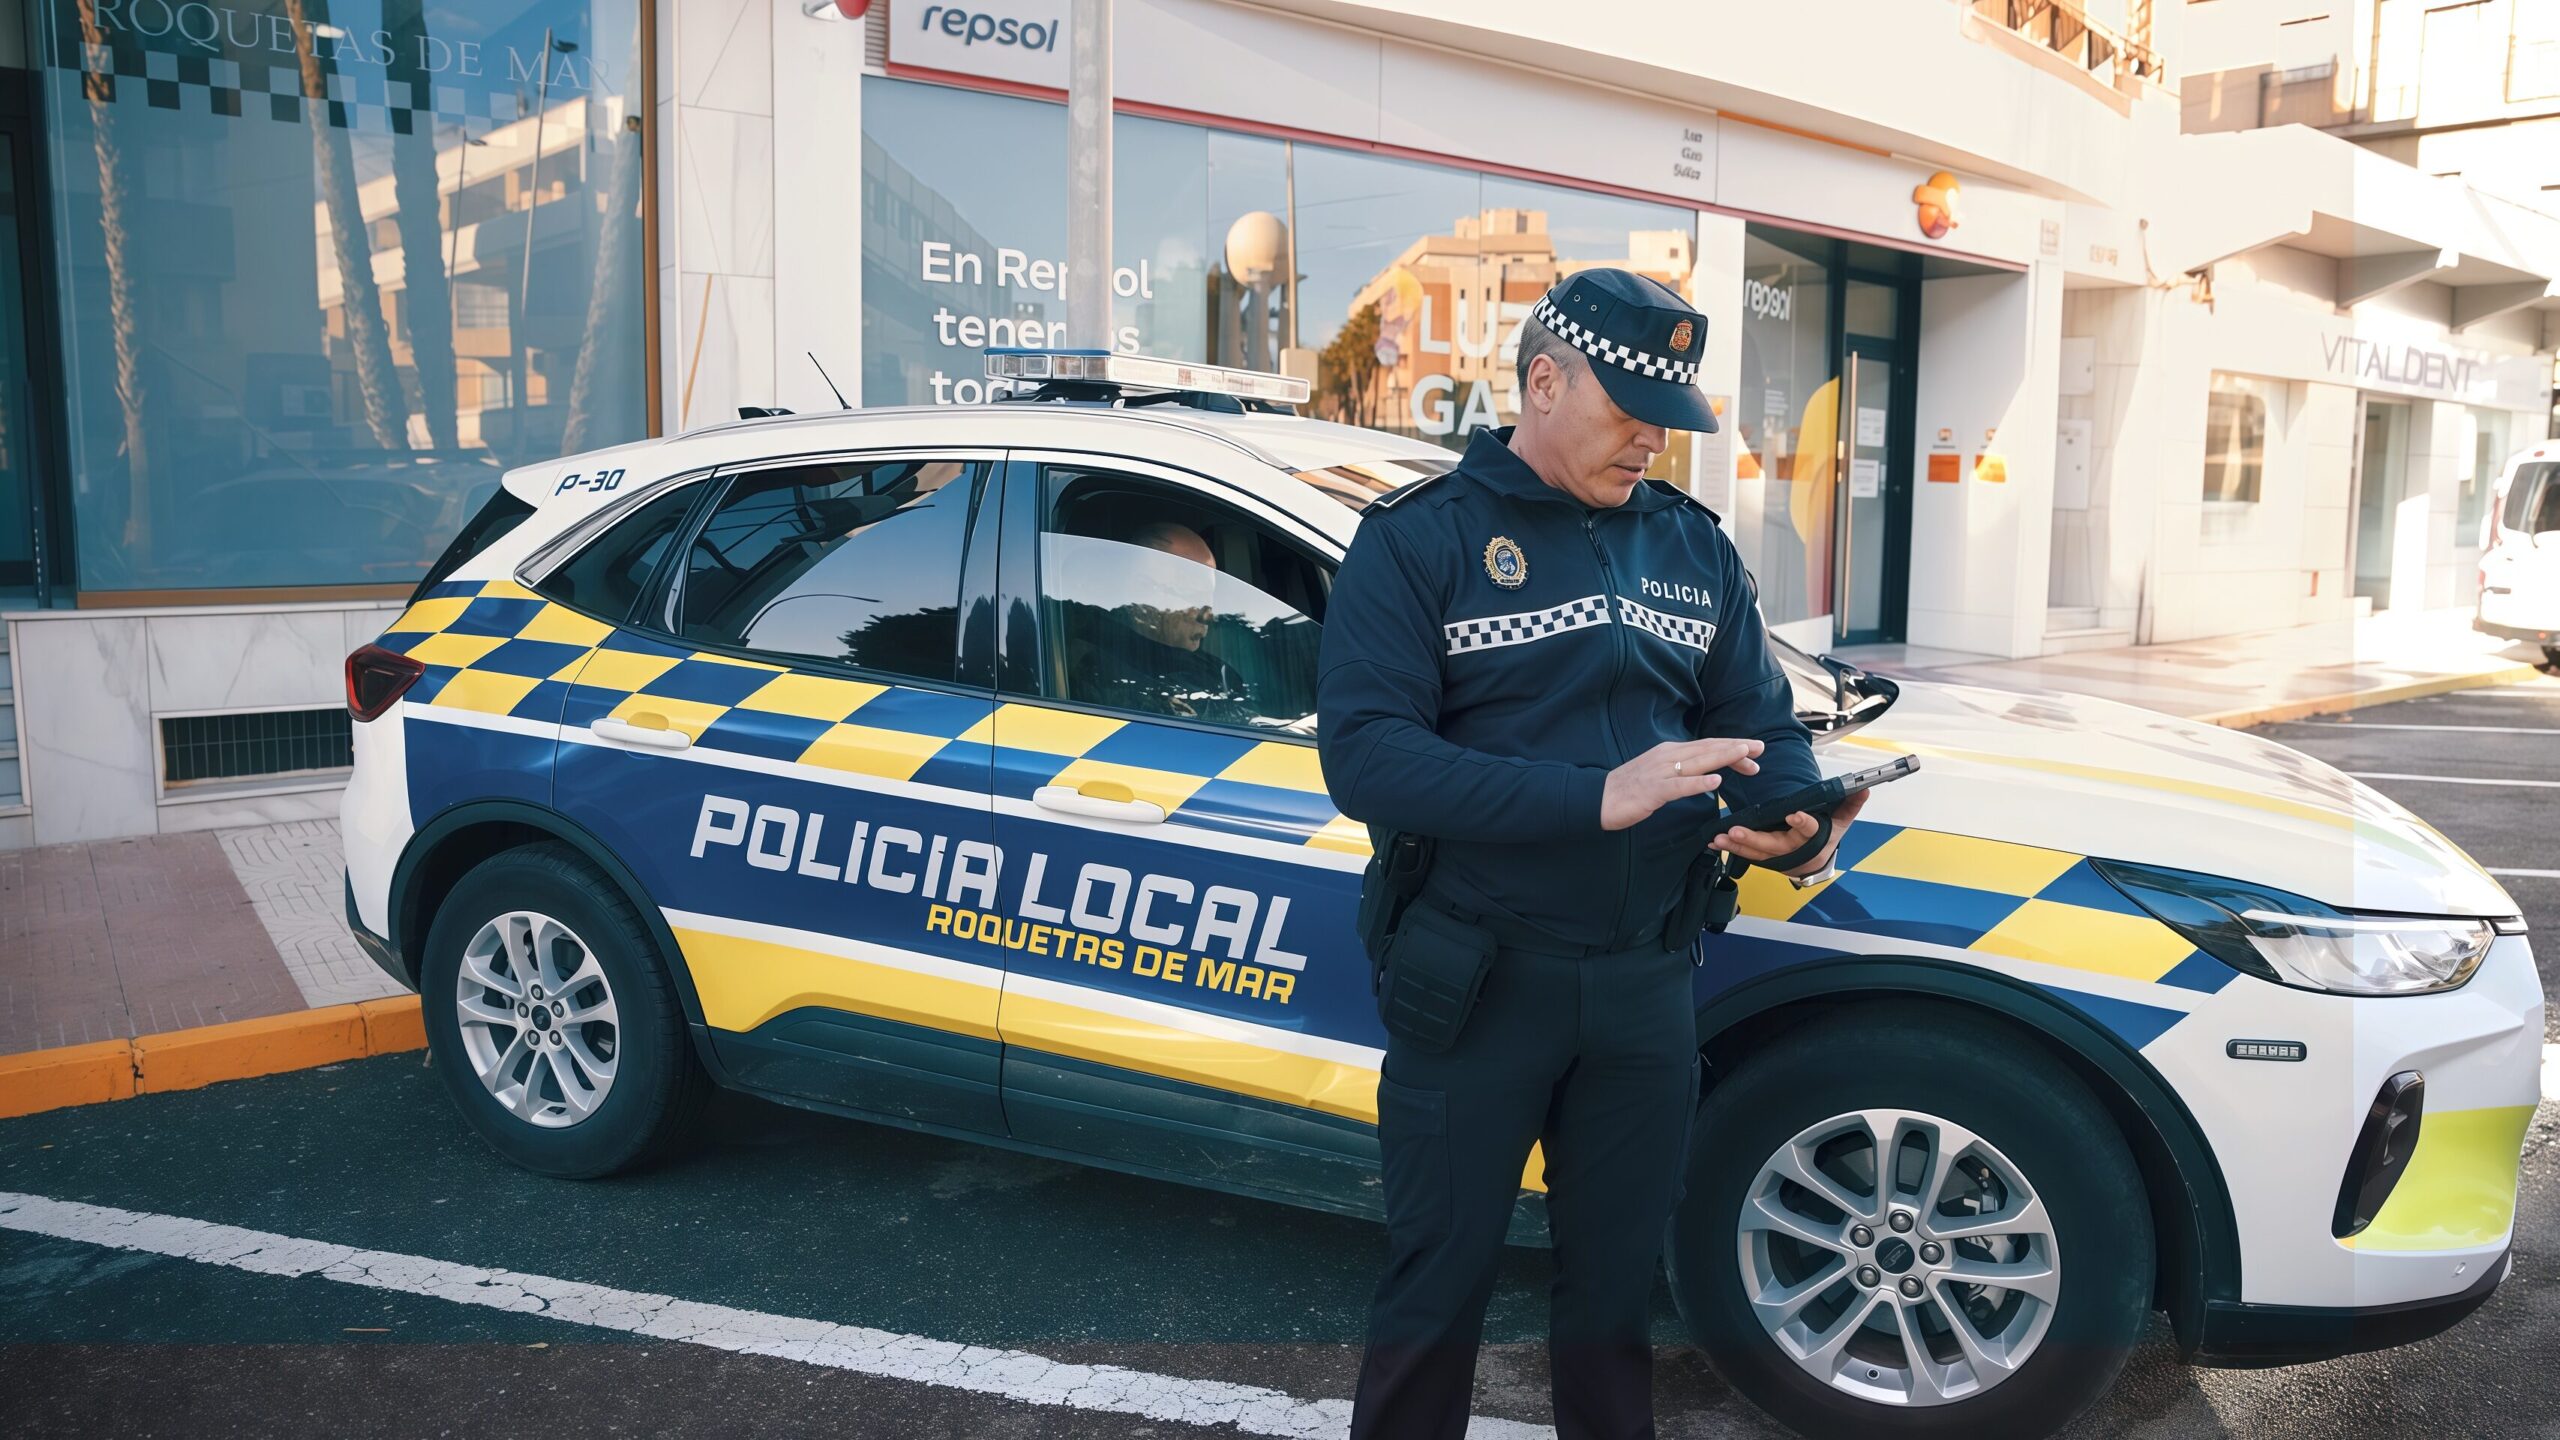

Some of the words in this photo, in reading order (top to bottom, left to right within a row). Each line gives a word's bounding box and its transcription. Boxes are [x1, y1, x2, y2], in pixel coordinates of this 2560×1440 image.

[94, 0, 396, 67] ROQUETAS
[414, 35, 484, 78] DE
[922, 5, 1059, 52] repsol
[921, 240, 983, 286] En
[997, 247, 1153, 301] Reol
[933, 307, 1141, 354] tenes
[2320, 330, 2480, 393] VITALDENT
[555, 468, 626, 497] P-30
[1640, 576, 1713, 609] POLICIA
[690, 793, 1005, 911] POLICIA
[1018, 852, 1308, 972] LOCAL
[926, 903, 1125, 970] ROQUETAS
[1131, 944, 1189, 984] DE
[1195, 956, 1297, 1005] MAR
